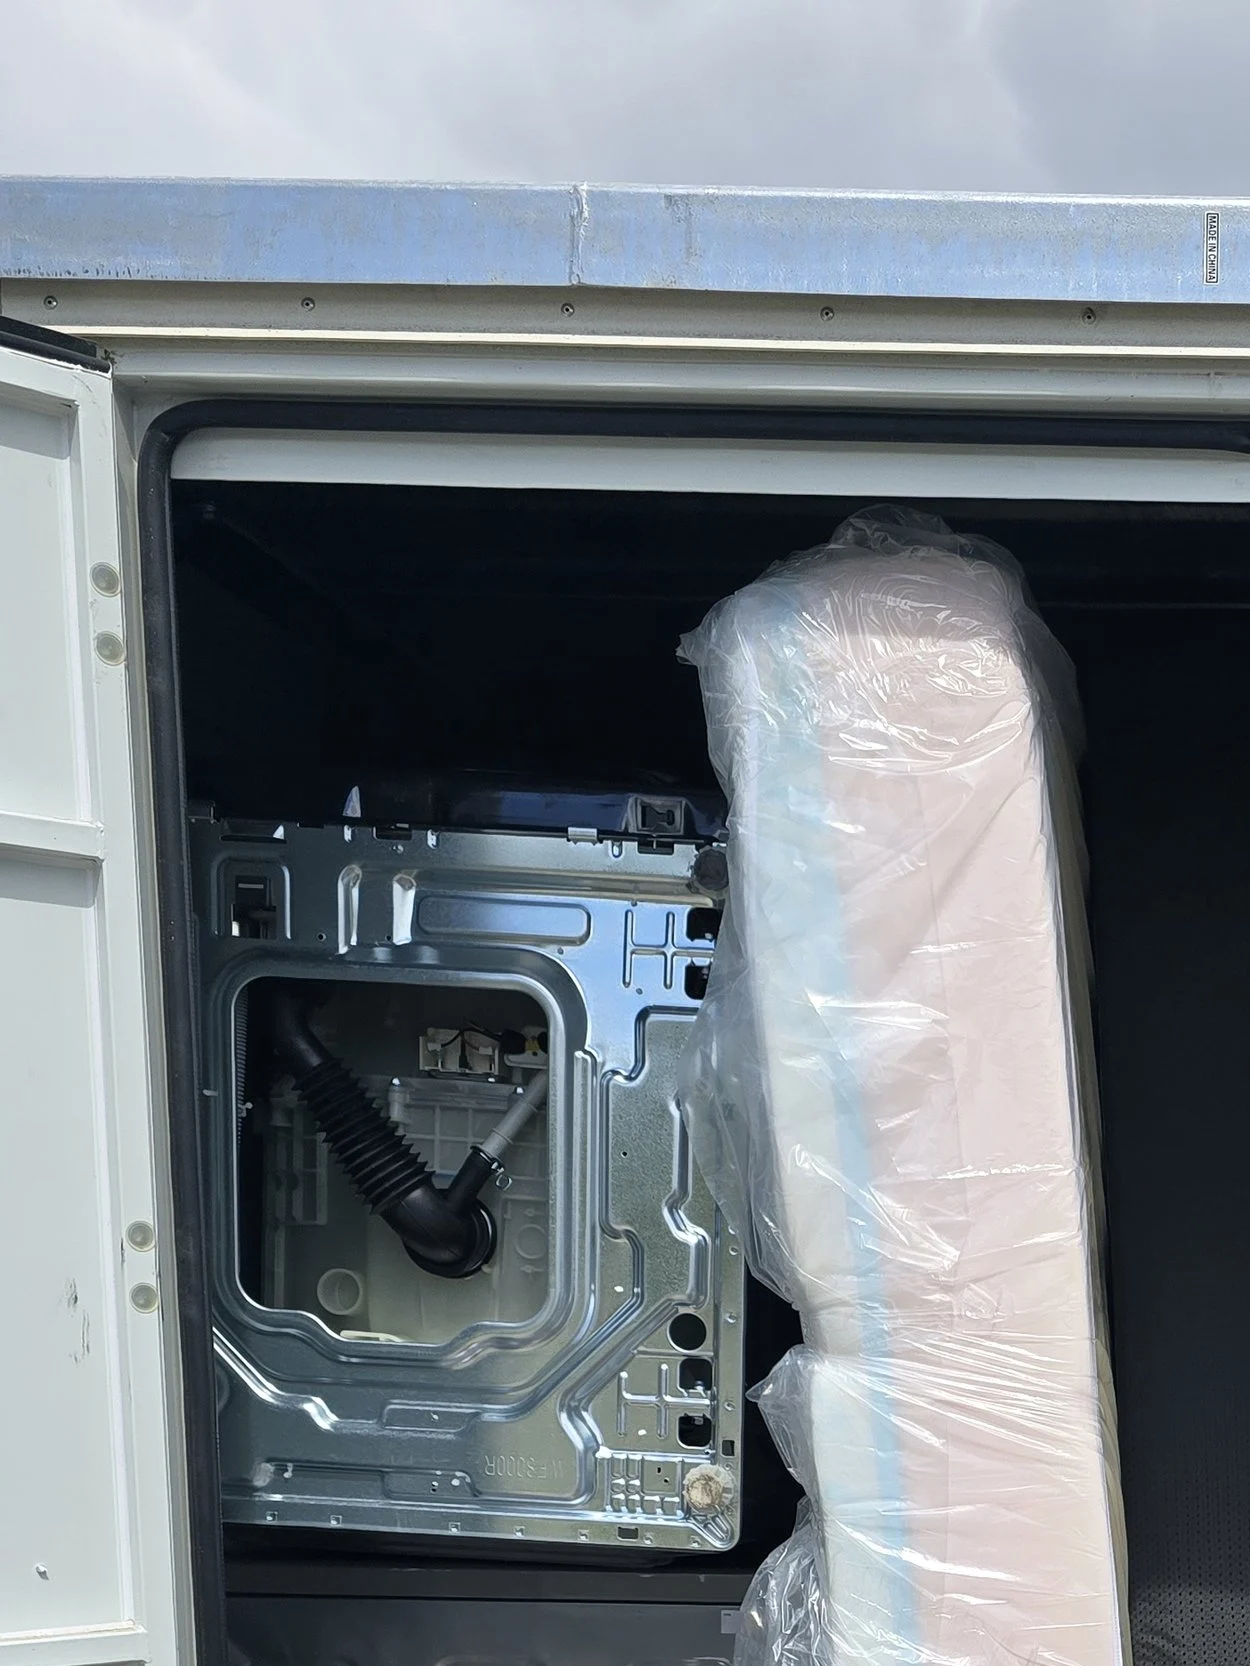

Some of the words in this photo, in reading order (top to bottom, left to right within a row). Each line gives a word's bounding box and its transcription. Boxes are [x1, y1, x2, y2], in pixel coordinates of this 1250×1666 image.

[1208, 215, 1217, 241] MADE
[1208, 243, 1217, 252] IN
[1207, 253, 1217, 281] CHINA
